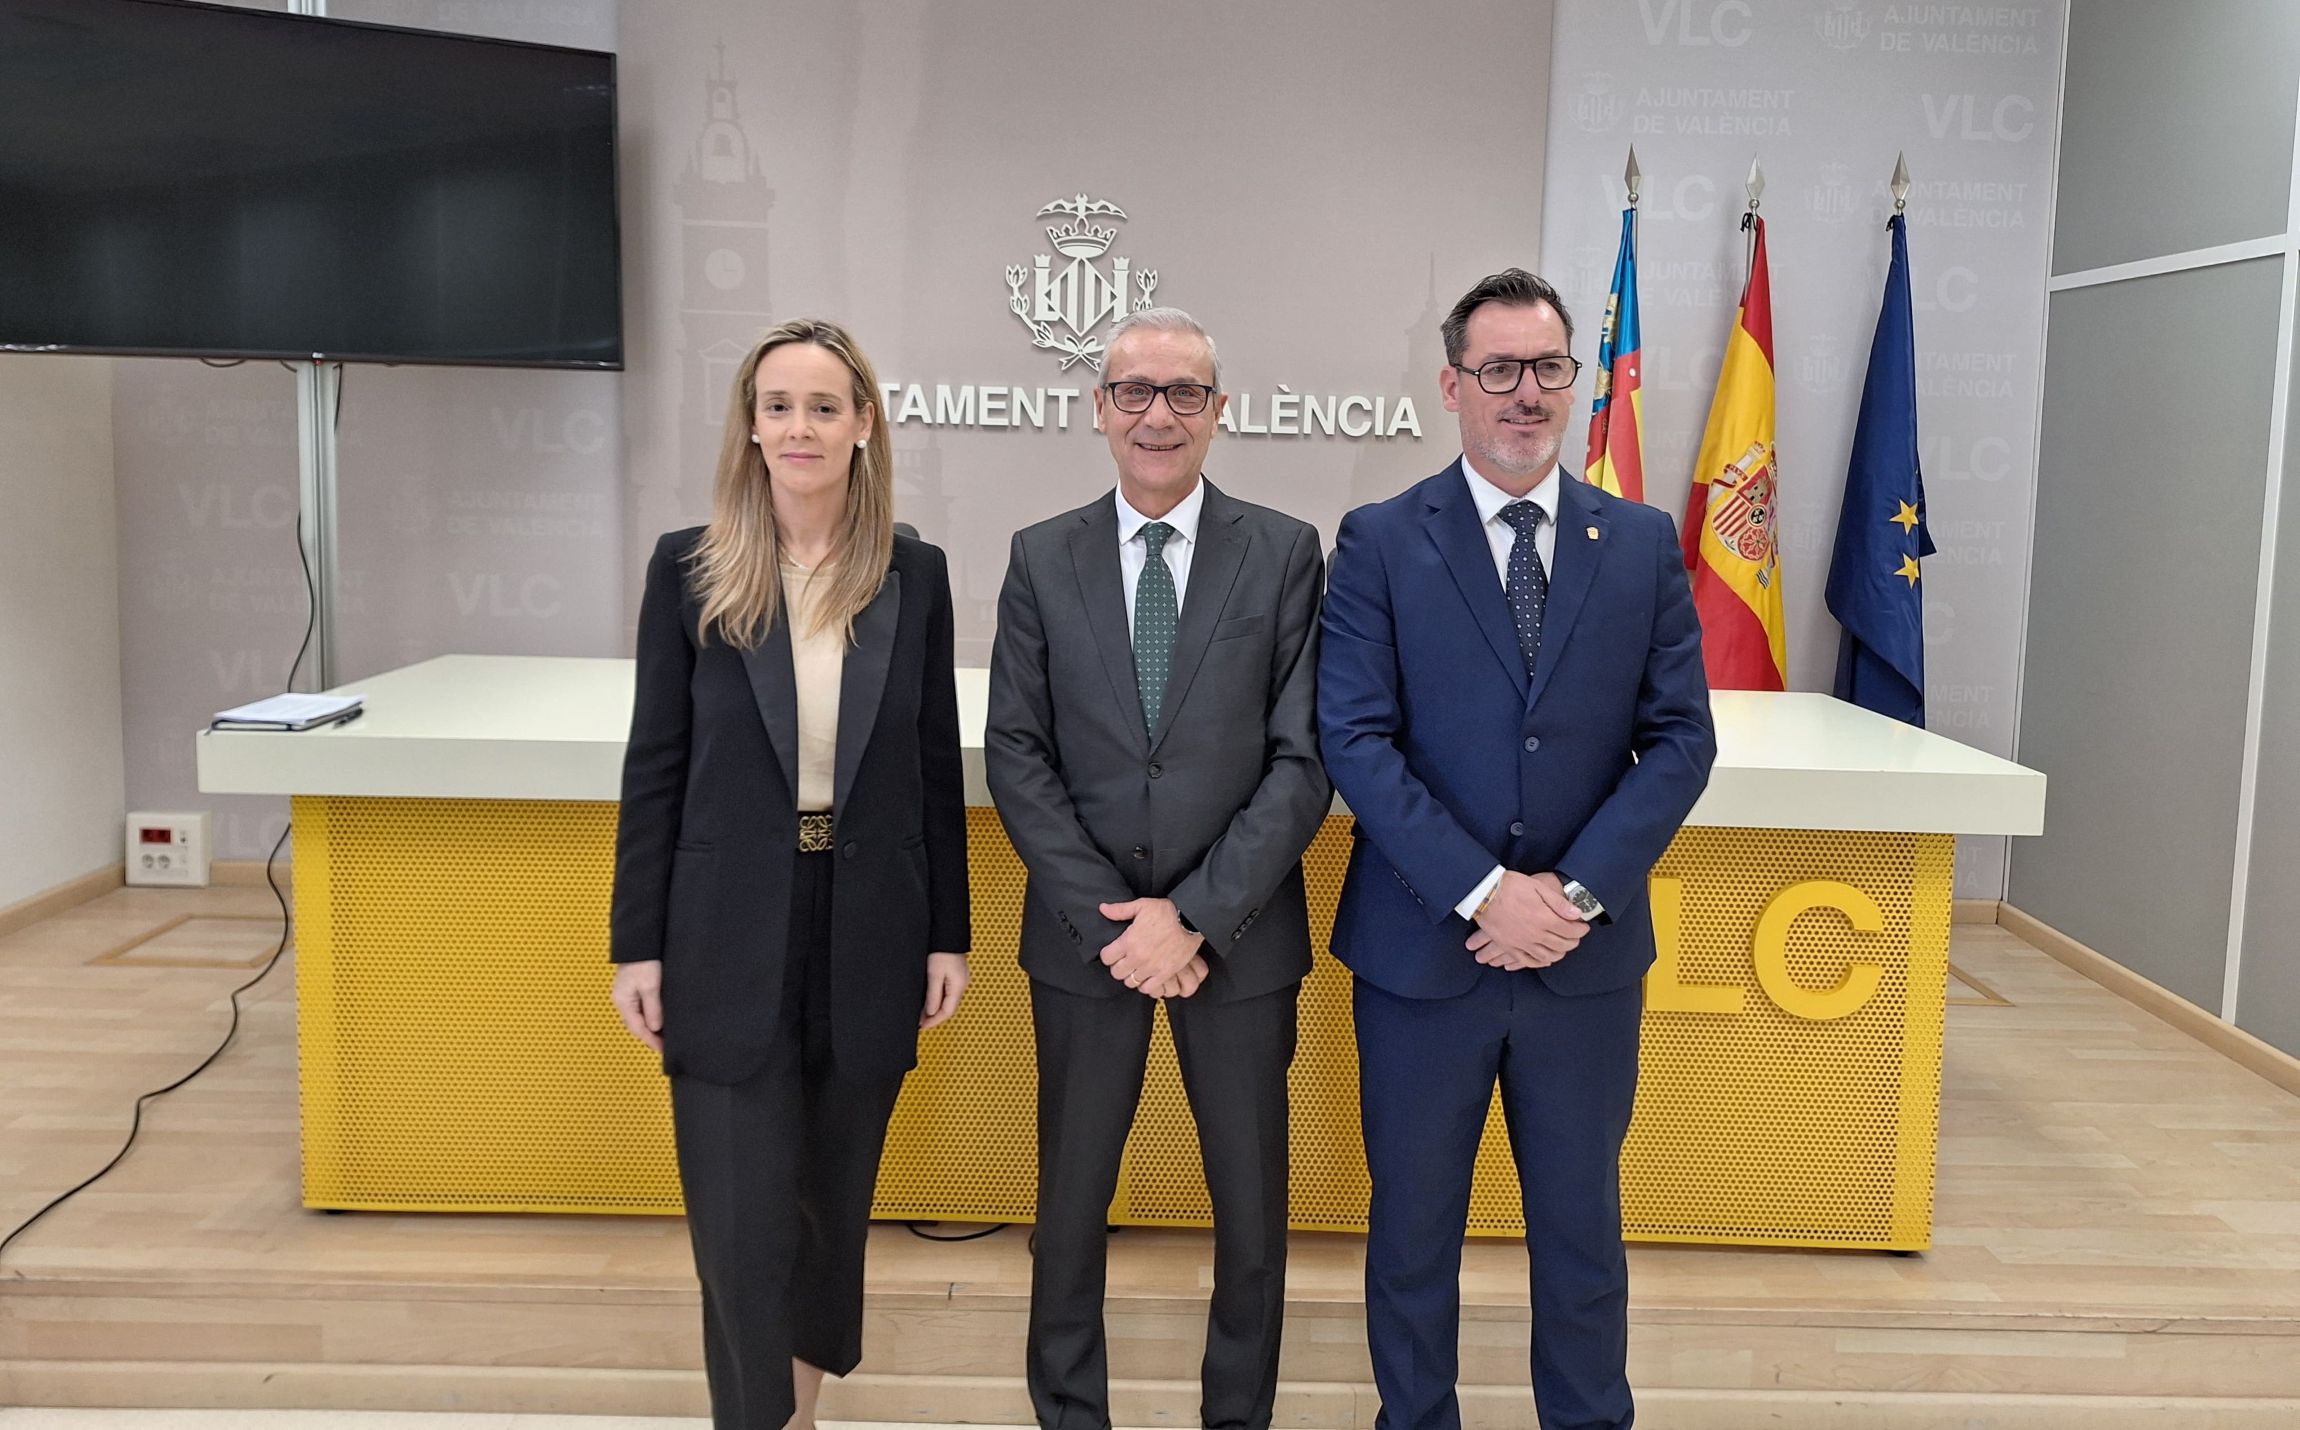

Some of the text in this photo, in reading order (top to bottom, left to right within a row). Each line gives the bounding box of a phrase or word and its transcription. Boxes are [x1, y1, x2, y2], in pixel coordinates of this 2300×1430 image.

[1637, 0, 1753, 47] VLC
[1883, 4, 2042, 28] AJUNTAMENT
[1879, 31, 1913, 52] DE
[1636, 86, 1796, 110] AJUNTAMENT
[1920, 93, 2035, 143] VLC
[1633, 114, 1666, 135] DE
[1911, 266, 1980, 313] LC
[1917, 352, 2018, 374] TAMENT
[879, 382, 1080, 429] TAMENT
[1217, 384, 1423, 437] ALÈNCIA
[447, 572, 561, 619] VLC
[1647, 876, 1884, 1020] LC
